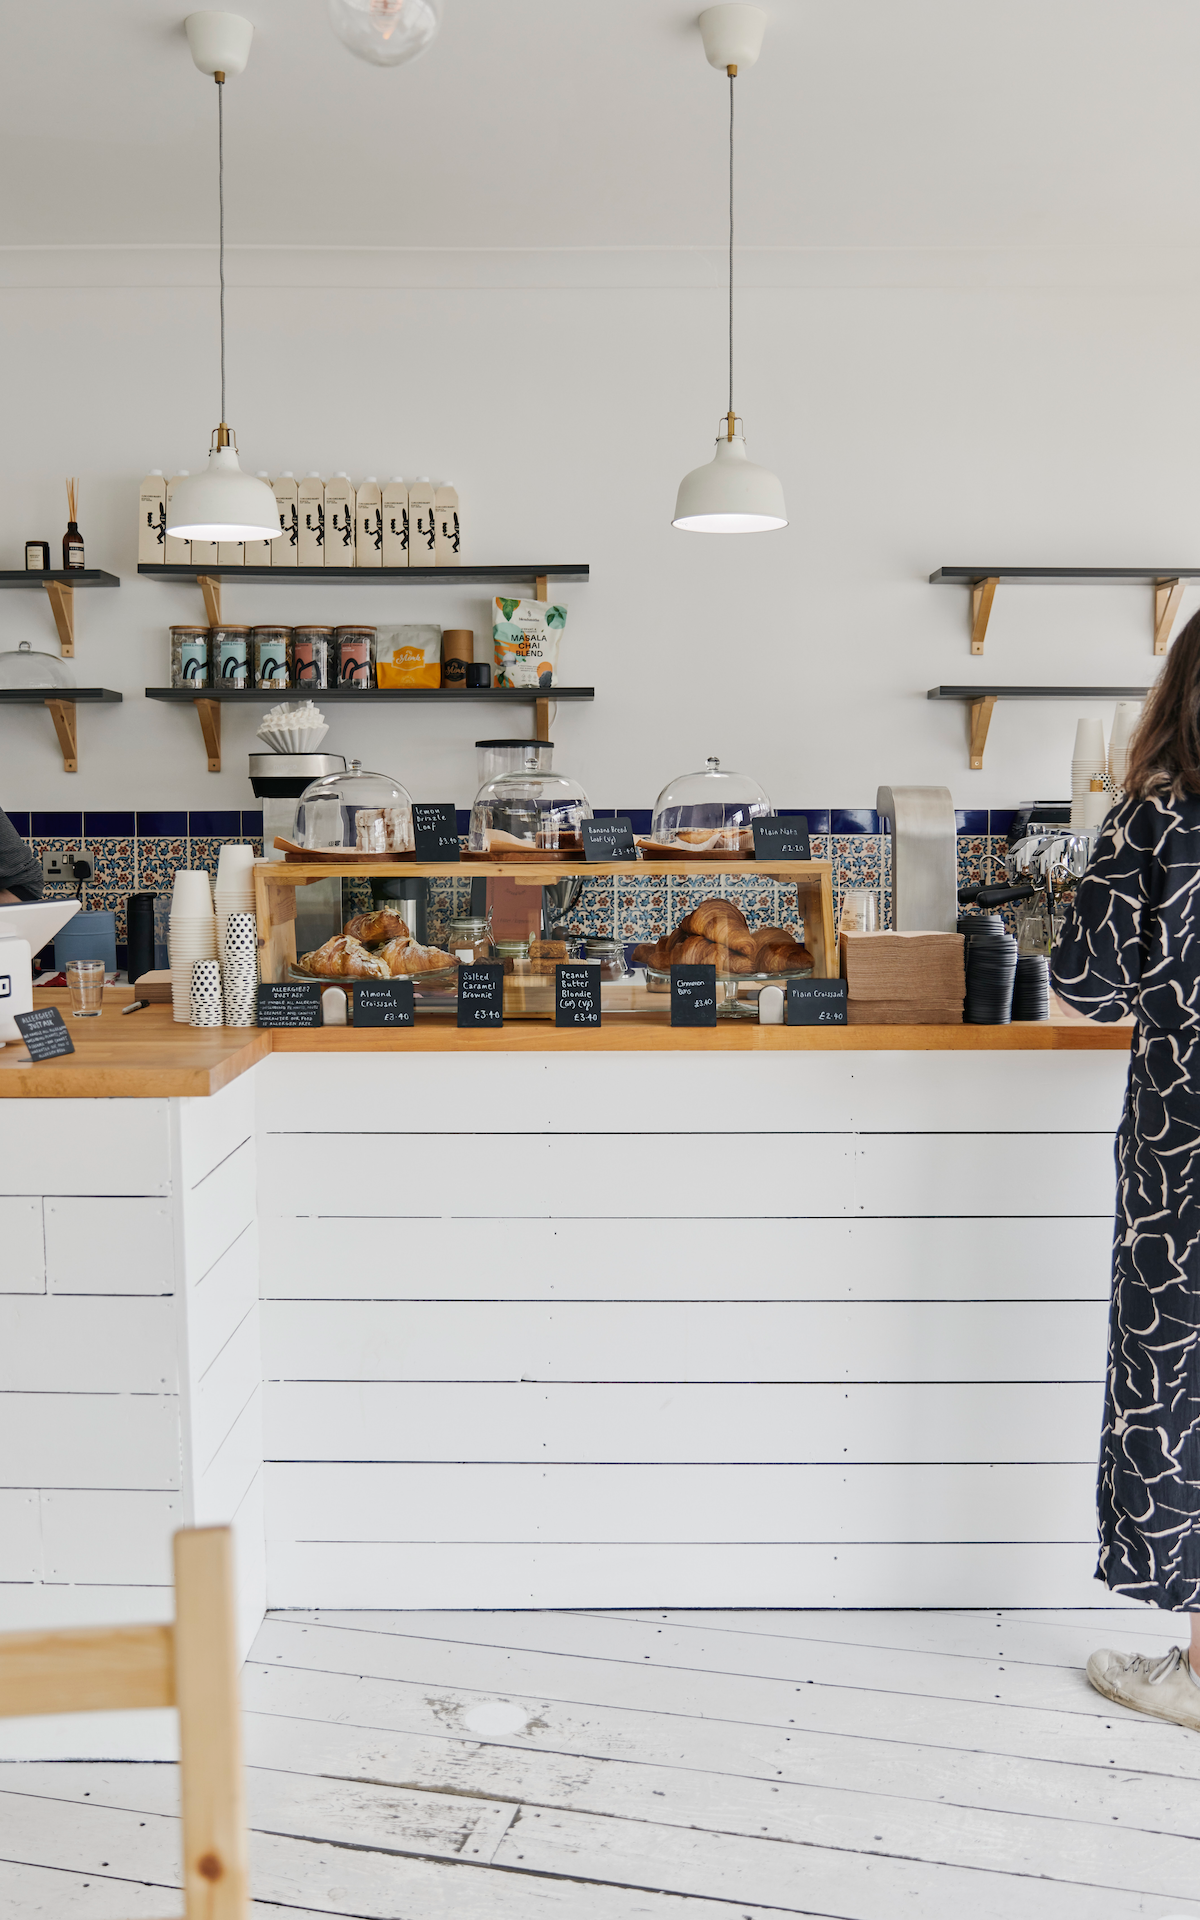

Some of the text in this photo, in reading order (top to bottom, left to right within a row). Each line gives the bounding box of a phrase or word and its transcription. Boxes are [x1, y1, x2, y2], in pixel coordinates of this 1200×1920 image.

[510, 634, 548, 642] MASALA
[518, 642, 540, 650] CHAI
[610, 825, 628, 833] Bread
[760, 827, 779, 836] Plain
[462, 971, 490, 981] Salted
[561, 970, 589, 979] Peanut
[462, 981, 496, 990] Caramel
[561, 979, 590, 988] Butter
[360, 989, 392, 998] Almond
[462, 991, 493, 1000] Brownie
[561, 989, 592, 998] Blondie
[792, 989, 844, 998] Plain Croissant
[360, 999, 398, 1008] Croissant
[28, 1020, 43, 1031] JUST
[42, 1019, 54, 1027] ASK
